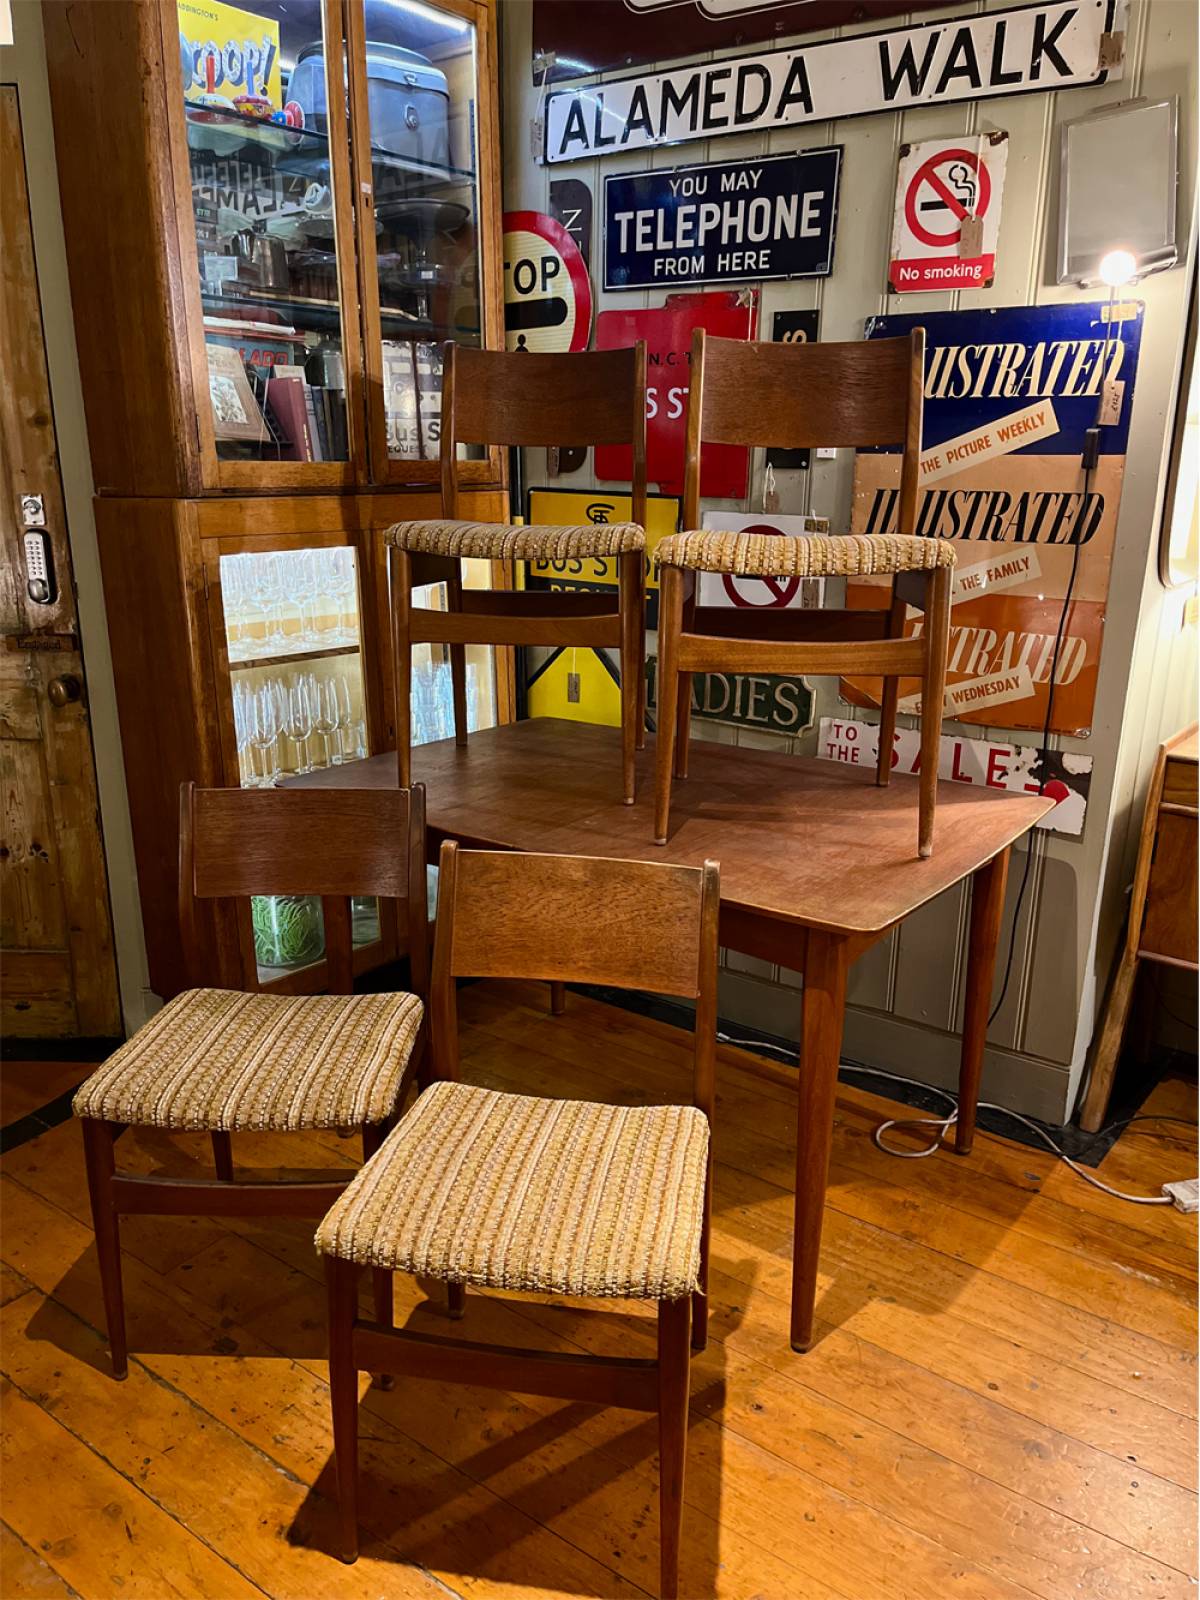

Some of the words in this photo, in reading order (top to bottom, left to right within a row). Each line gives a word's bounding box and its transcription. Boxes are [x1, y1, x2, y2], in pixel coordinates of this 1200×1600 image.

[177, 2, 219, 21] ADDINGTON'S
[559, 55, 814, 155] ALAMEDA
[878, 8, 1079, 101] WALK
[669, 176, 708, 198] YOU
[720, 169, 763, 193] MAY
[614, 191, 825, 254] TELEPHONE
[504, 256, 560, 295] OP
[653, 254, 705, 277] FROM
[717, 249, 771, 273] HERE
[899, 266, 920, 281] No
[923, 262, 983, 283] smoking
[923, 339, 1125, 399] USTRATED
[920, 457, 942, 475] THE
[946, 435, 992, 464] PICTURE
[996, 411, 1046, 443] WEEKLY
[864, 488, 1105, 546] ILUSTRATED
[960, 574, 982, 592] THE
[986, 556, 1031, 583] FAMILY
[912, 623, 1087, 686] TRATED
[691, 673, 799, 726] DIES
[951, 675, 1021, 704] WEDNESDAY
[833, 723, 858, 741] TO
[826, 742, 859, 763] THE
